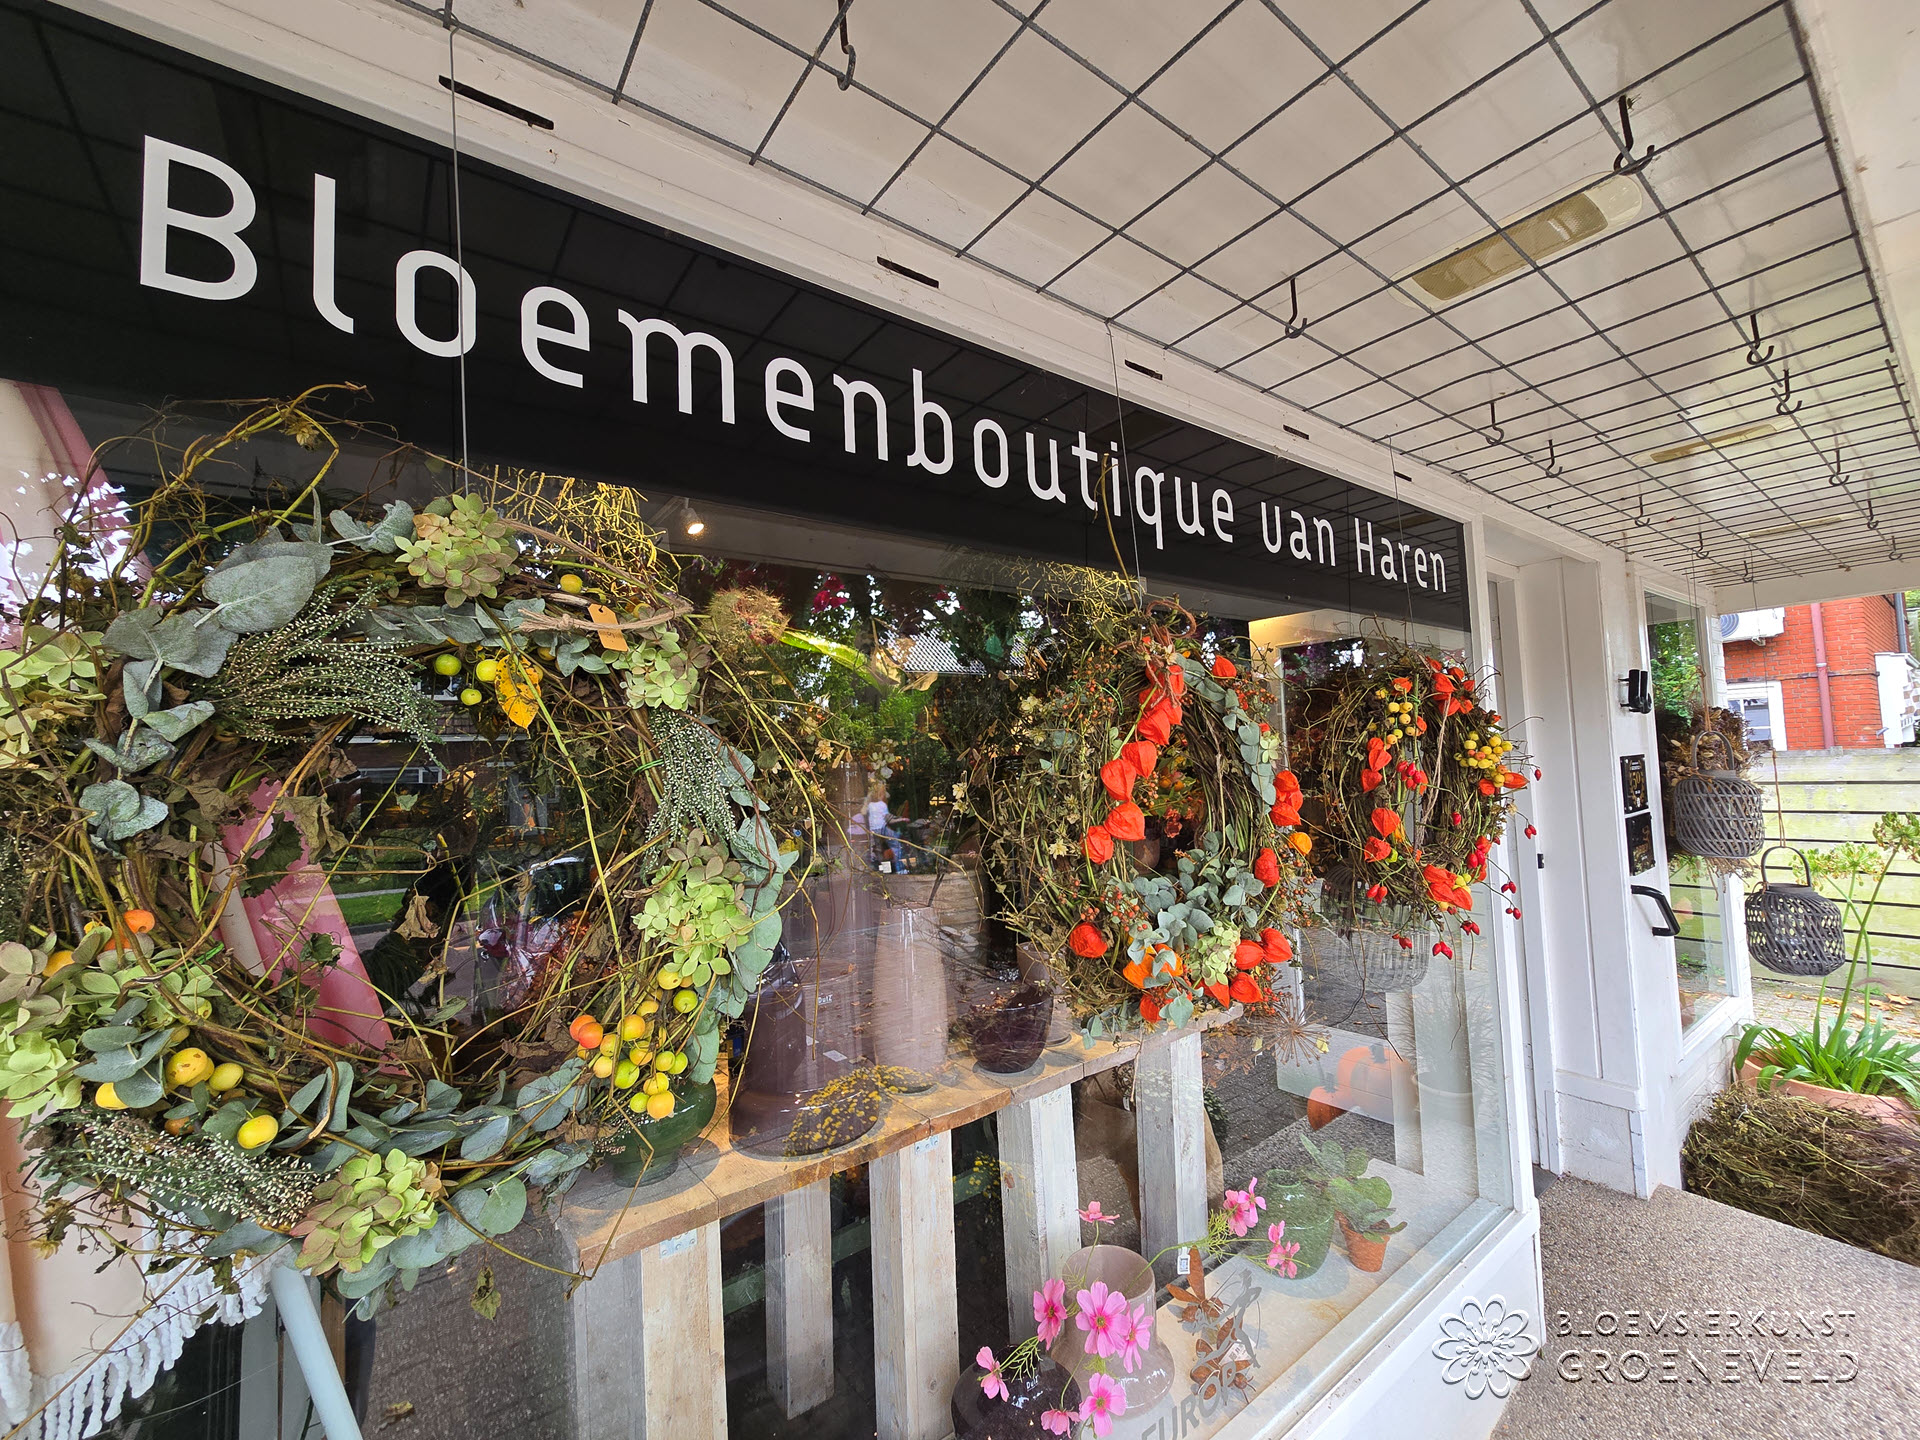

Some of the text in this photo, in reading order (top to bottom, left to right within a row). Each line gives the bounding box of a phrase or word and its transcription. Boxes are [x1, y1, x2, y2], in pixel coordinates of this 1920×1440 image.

[140, 135, 1447, 593] Bloemenboutique van Haren
